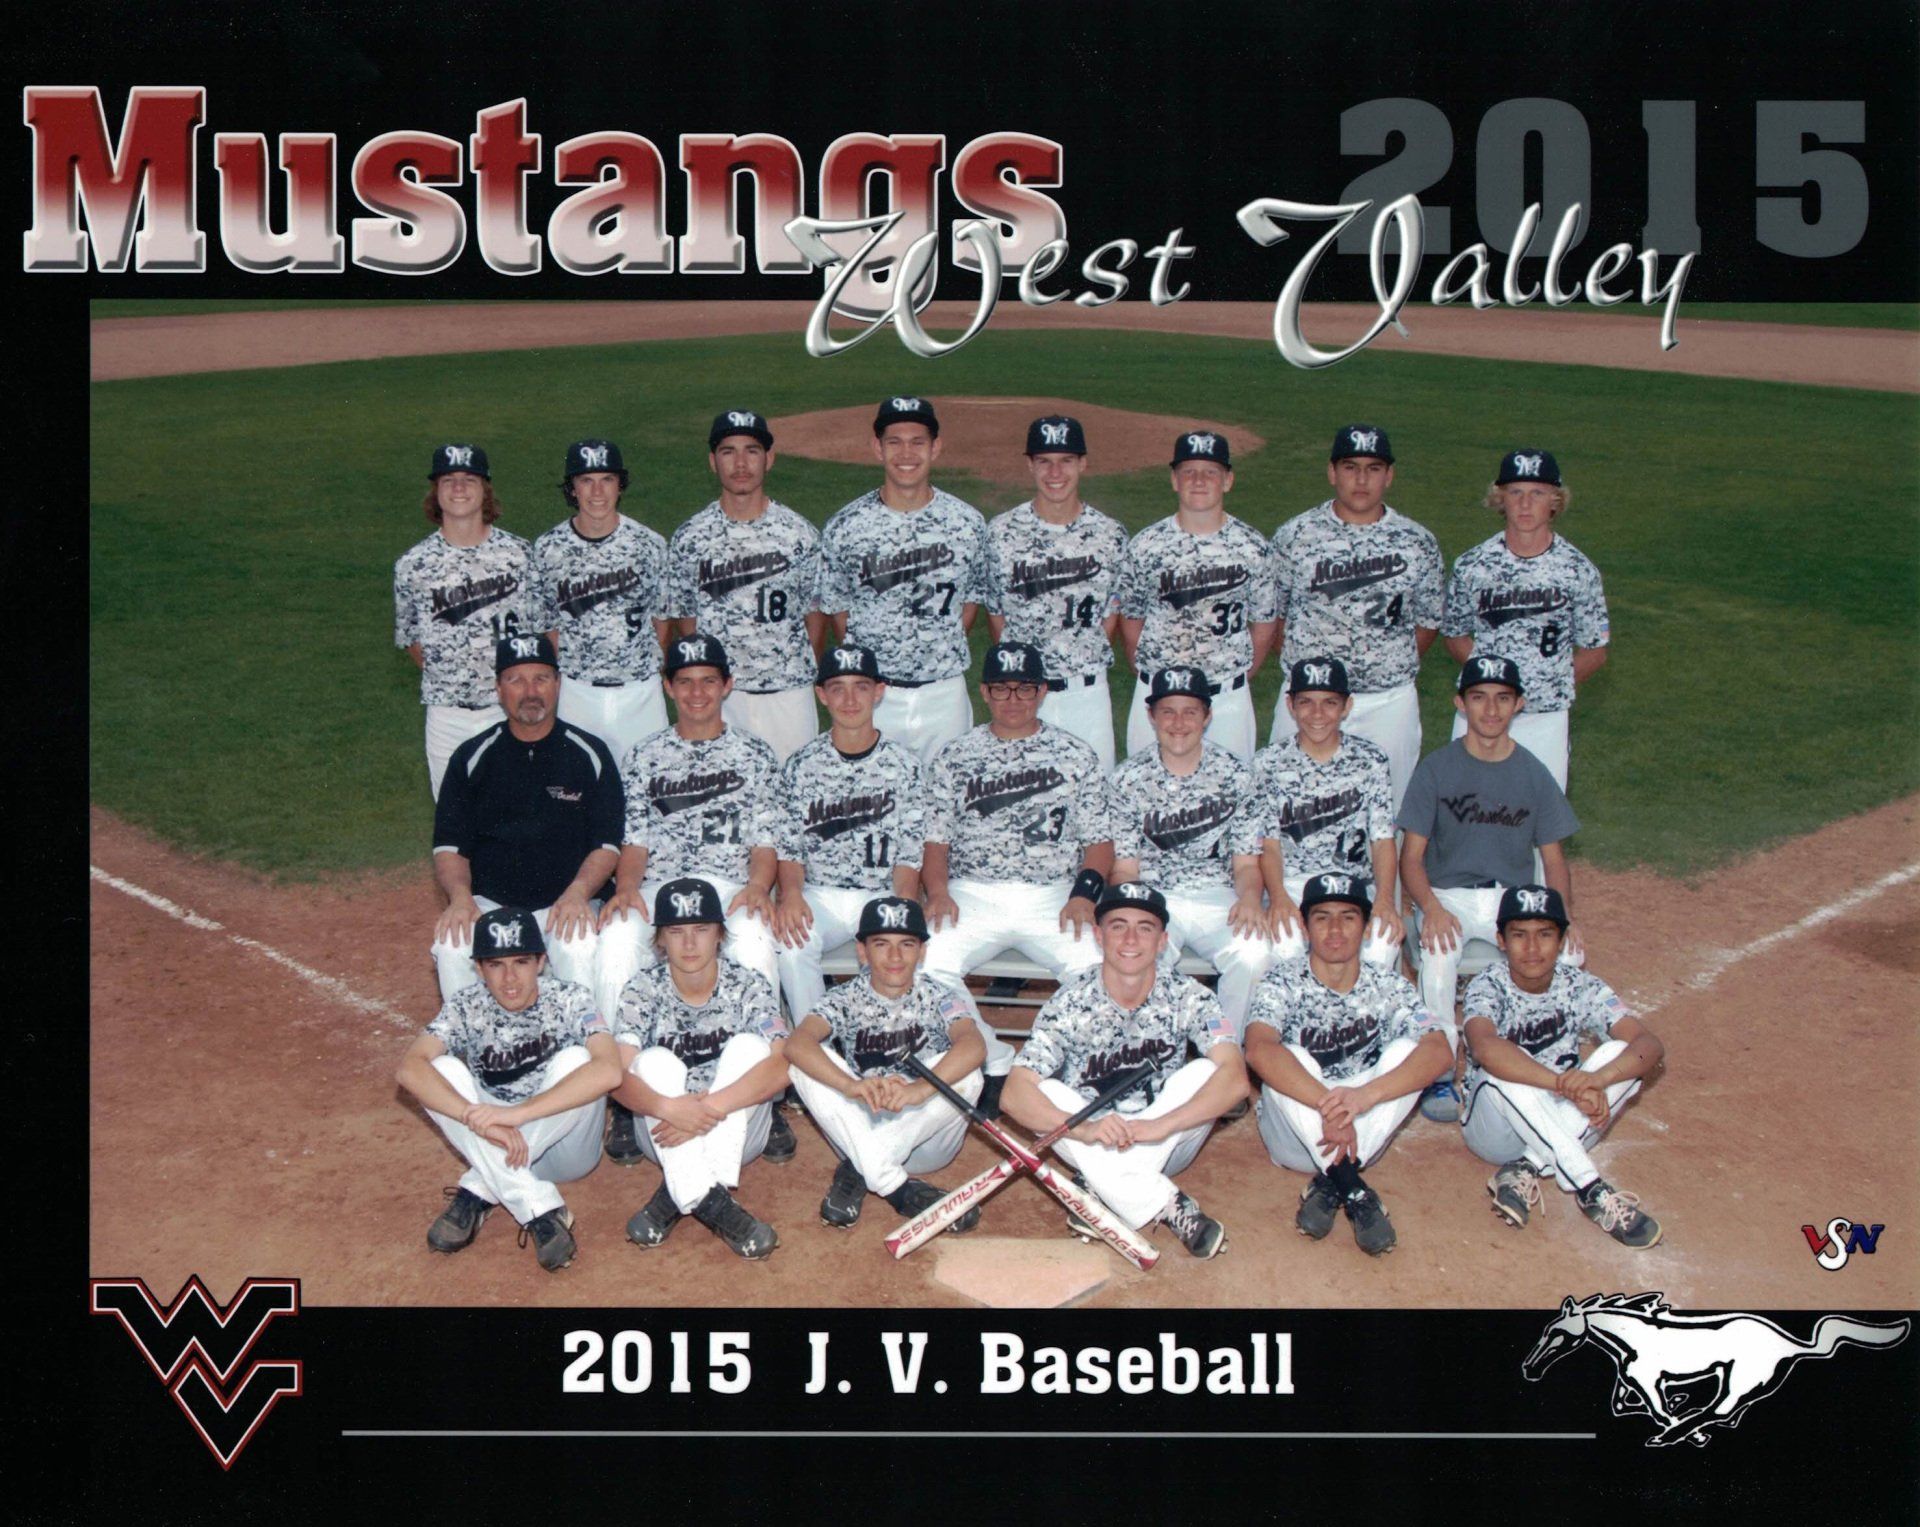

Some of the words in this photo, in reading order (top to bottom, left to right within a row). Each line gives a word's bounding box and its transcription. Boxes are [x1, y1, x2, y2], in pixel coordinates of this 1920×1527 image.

[699, 550, 791, 583] Mustangs
[1160, 562, 1249, 597] Mustangs
[1311, 553, 1408, 585] Mustangs
[430, 571, 519, 614] Mustangs
[556, 566, 641, 608] Mustangs
[753, 583, 788, 623] 18
[1477, 587, 1569, 612] Mustangs
[491, 608, 520, 641] 16
[625, 606, 645, 639] 5
[1060, 595, 1095, 629] 14
[1363, 592, 1404, 630] 24
[1539, 624, 1561, 658] 8
[648, 769, 747, 800] Mustangs
[963, 767, 1066, 803] Mustangs
[702, 808, 742, 845] 21
[1021, 806, 1067, 843] 23
[862, 833, 890, 869] 11
[1331, 828, 1368, 865] 12
[900, 1174, 990, 1245] RAWLINGS
[1056, 1185, 1143, 1260] RAWLINGS
